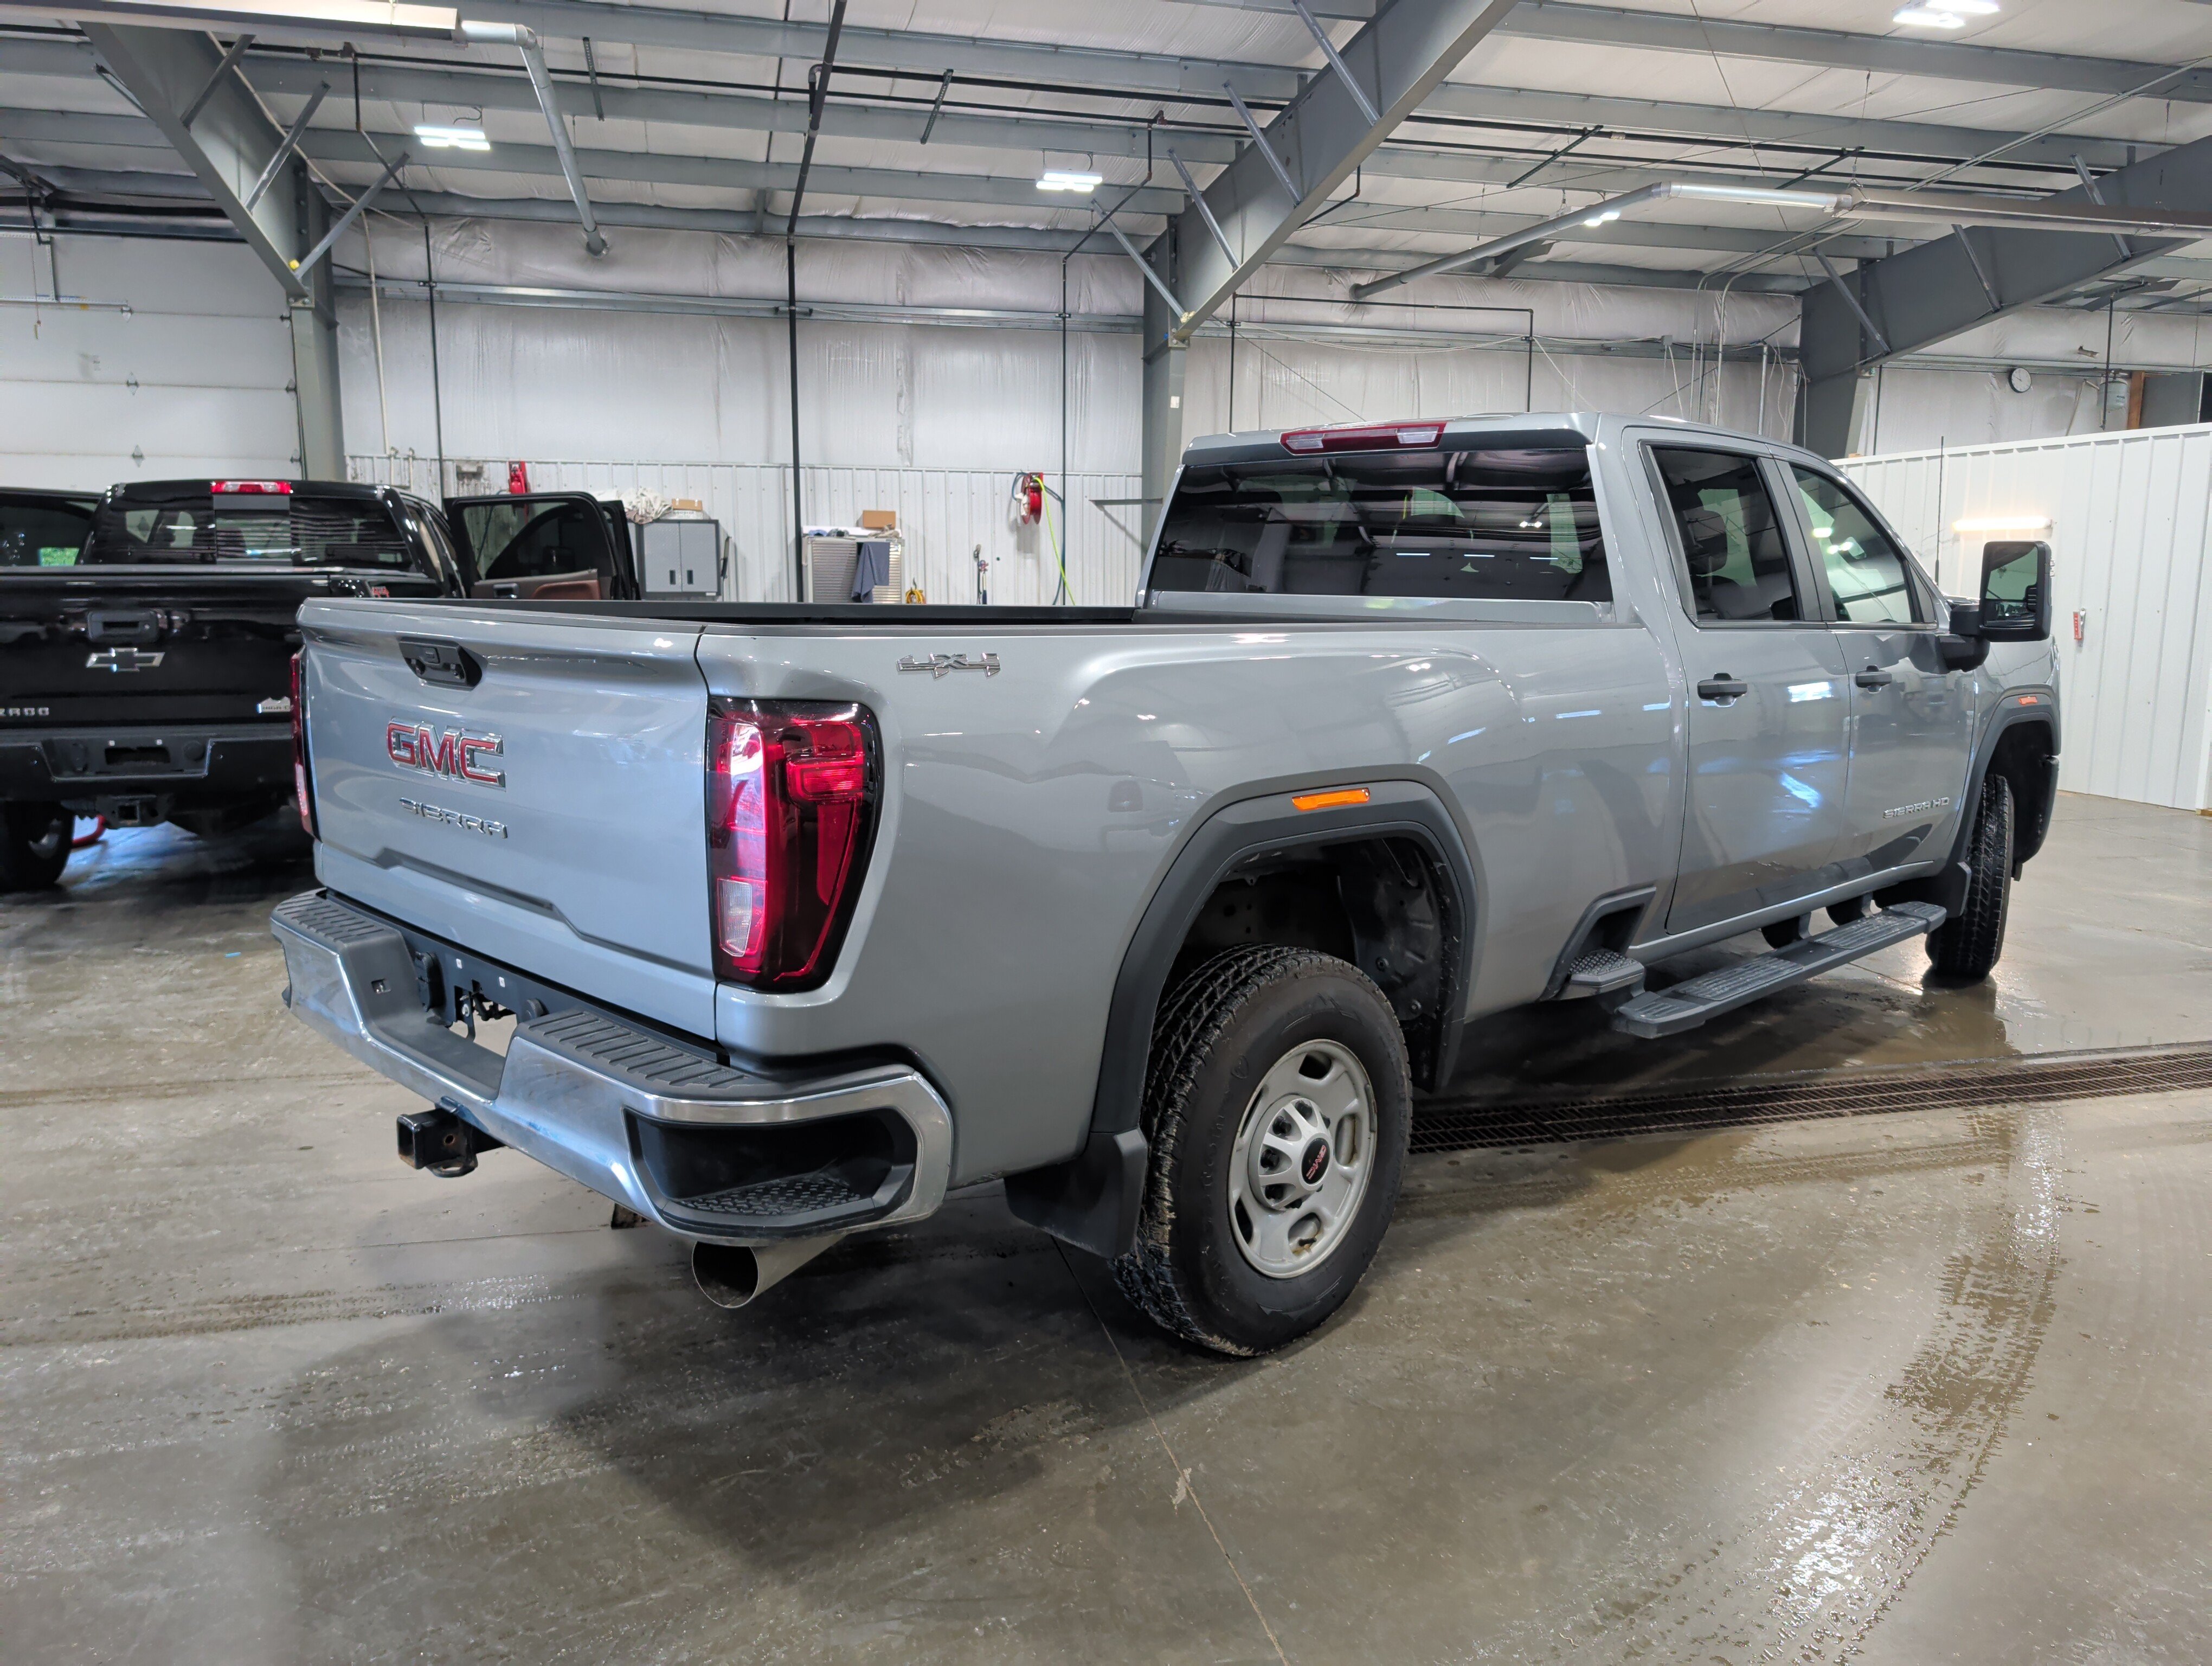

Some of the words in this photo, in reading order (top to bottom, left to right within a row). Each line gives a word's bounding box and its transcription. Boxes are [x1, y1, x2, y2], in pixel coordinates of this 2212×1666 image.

[387, 716, 506, 791] GMC
[400, 797, 508, 839] SIERRA
[1883, 800, 1932, 818] SIERRA
[1932, 797, 1950, 808] HD
[1306, 1145, 1327, 1180] GMC
